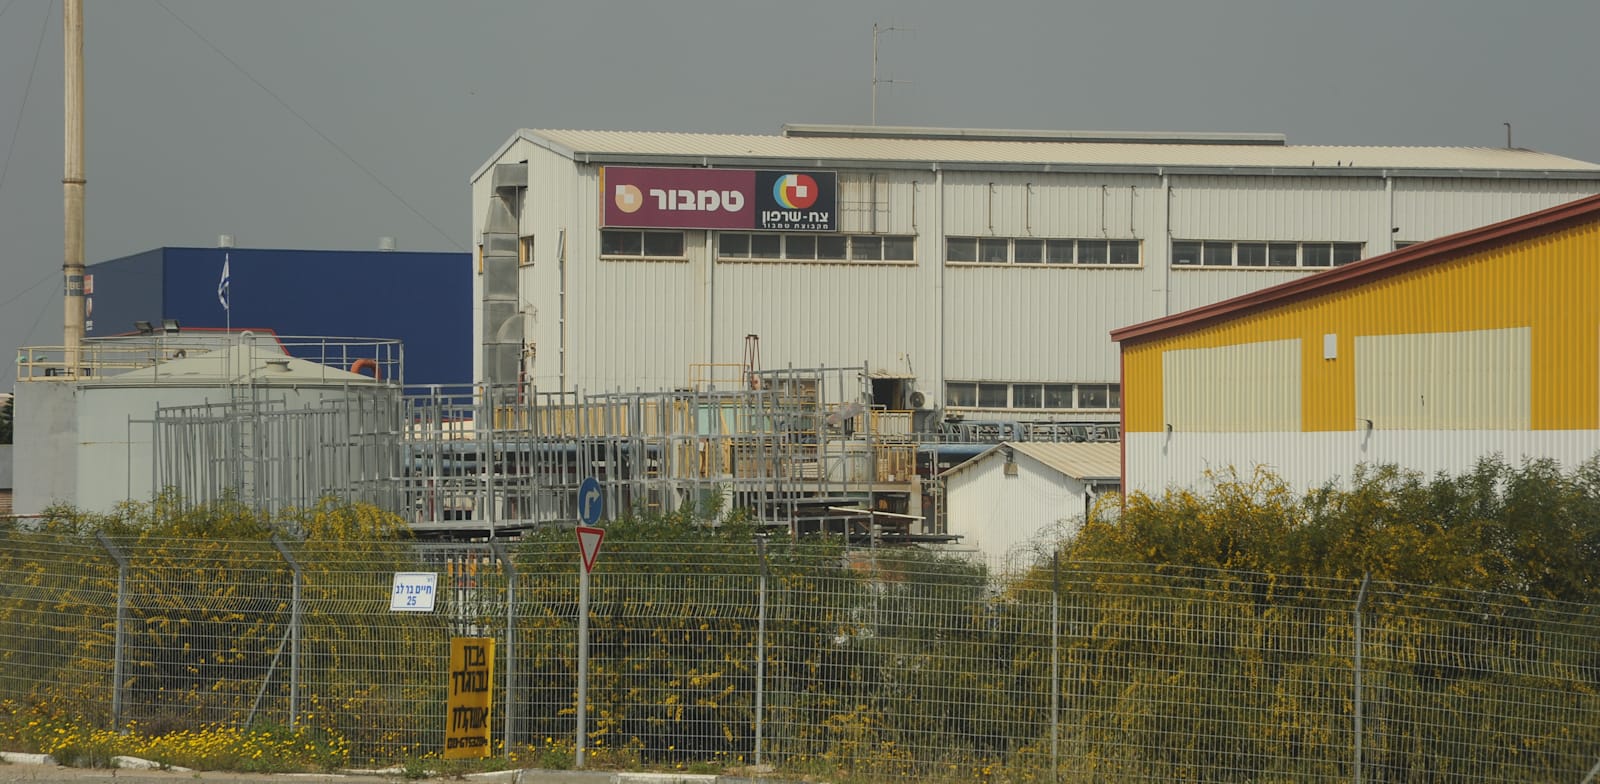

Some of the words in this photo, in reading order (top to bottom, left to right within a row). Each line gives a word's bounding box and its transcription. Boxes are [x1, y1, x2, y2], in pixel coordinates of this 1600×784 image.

[650, 188, 745, 212] טמבור
[762, 210, 829, 224] צח-שרפון
[415, 585, 432, 594] חיים
[406, 596, 417, 606] 25
[453, 705, 489, 733] אשקלון
